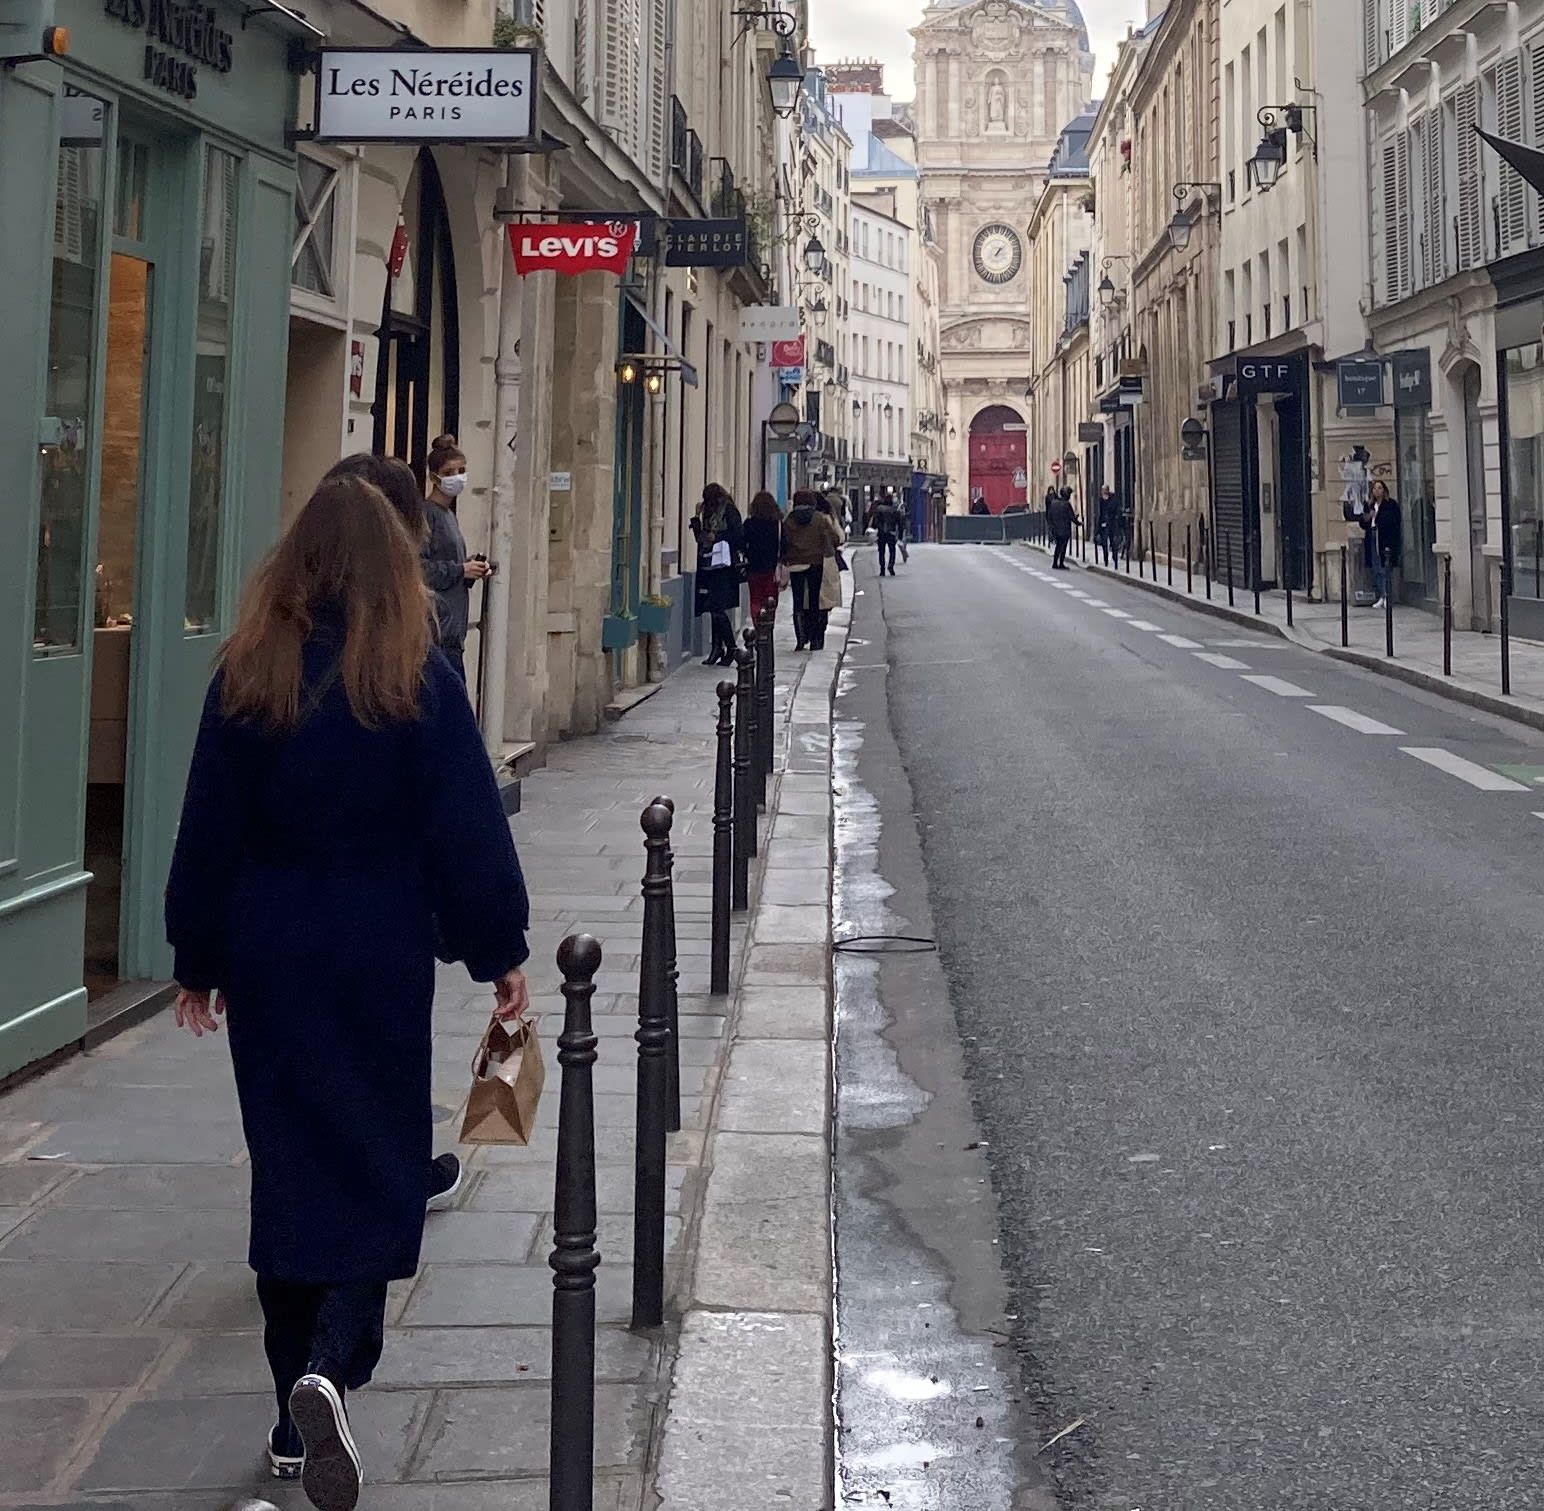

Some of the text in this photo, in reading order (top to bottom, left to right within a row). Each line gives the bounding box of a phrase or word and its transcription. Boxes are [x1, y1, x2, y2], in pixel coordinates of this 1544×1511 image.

[327, 67, 523, 97] Les Néréides
[389, 105, 462, 120] PARIS
[1241, 364, 1290, 379] GTF
